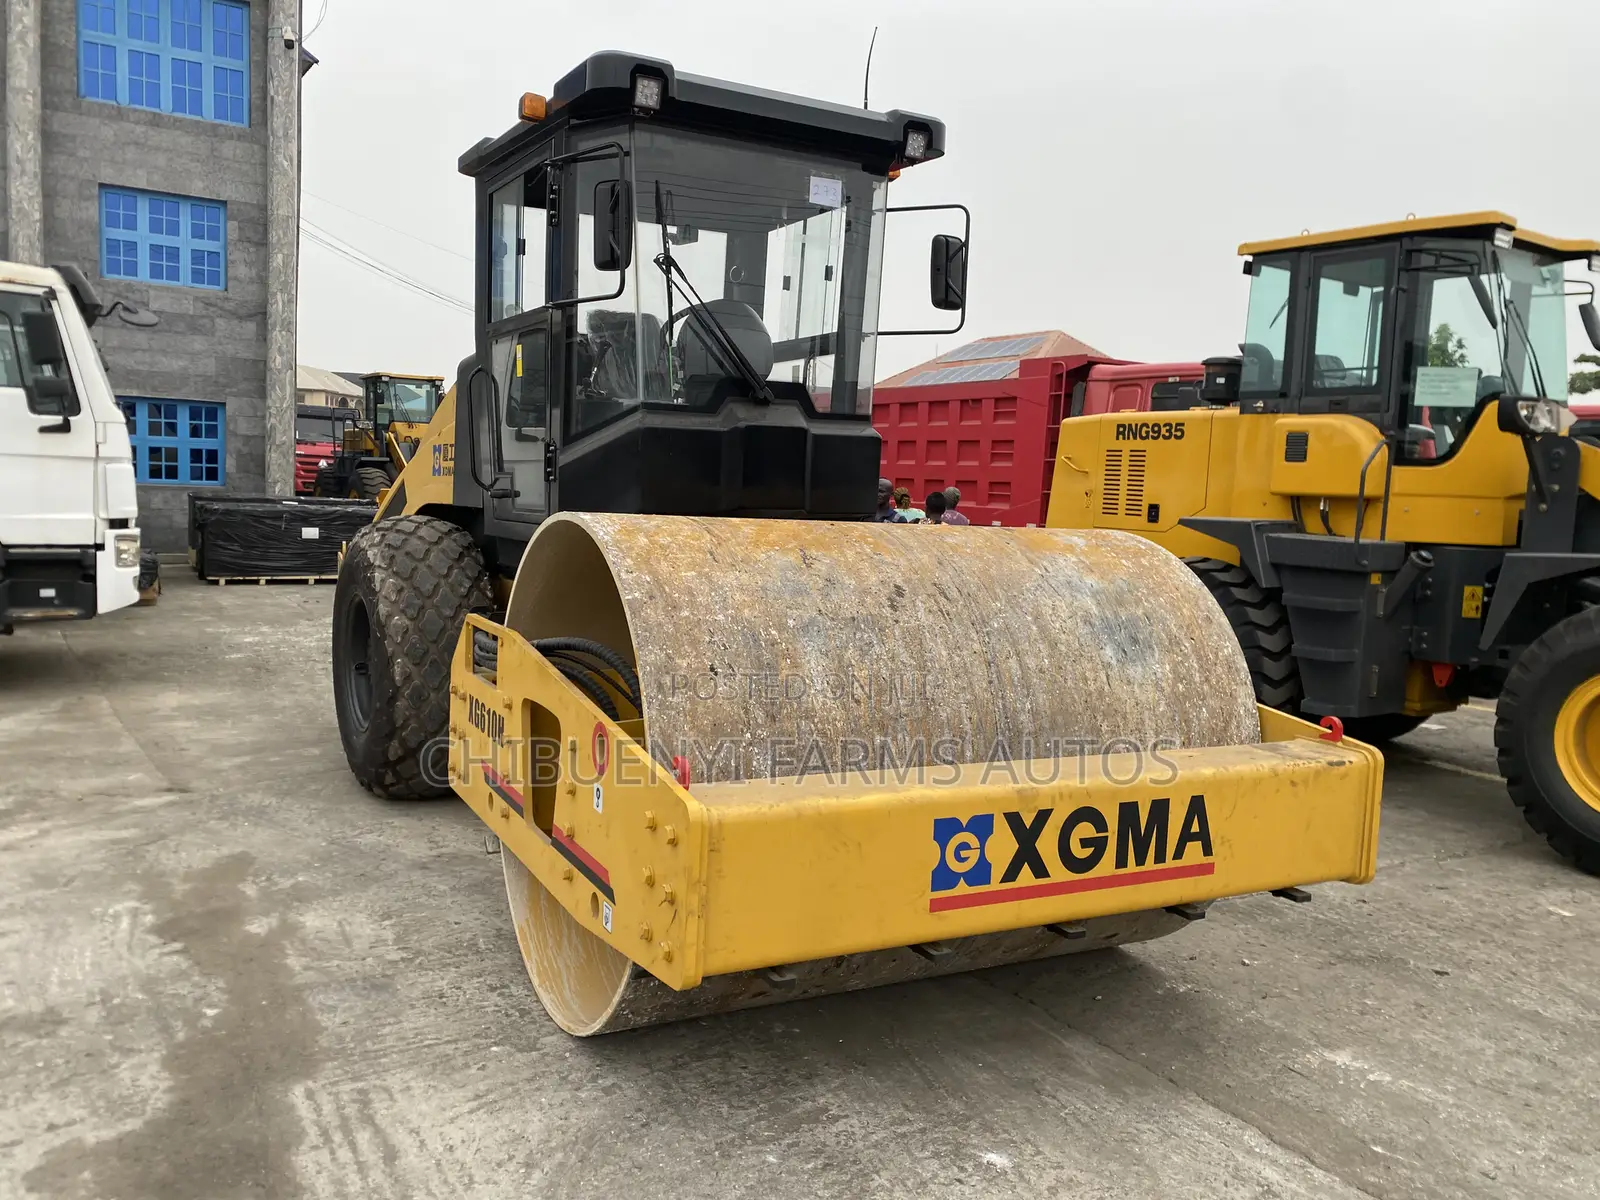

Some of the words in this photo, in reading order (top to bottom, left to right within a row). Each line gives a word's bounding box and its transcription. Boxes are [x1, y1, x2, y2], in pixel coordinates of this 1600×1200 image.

[1115, 422, 1186, 441] RNG935
[468, 693, 504, 748] XG610H
[998, 794, 1214, 885] XGMA
